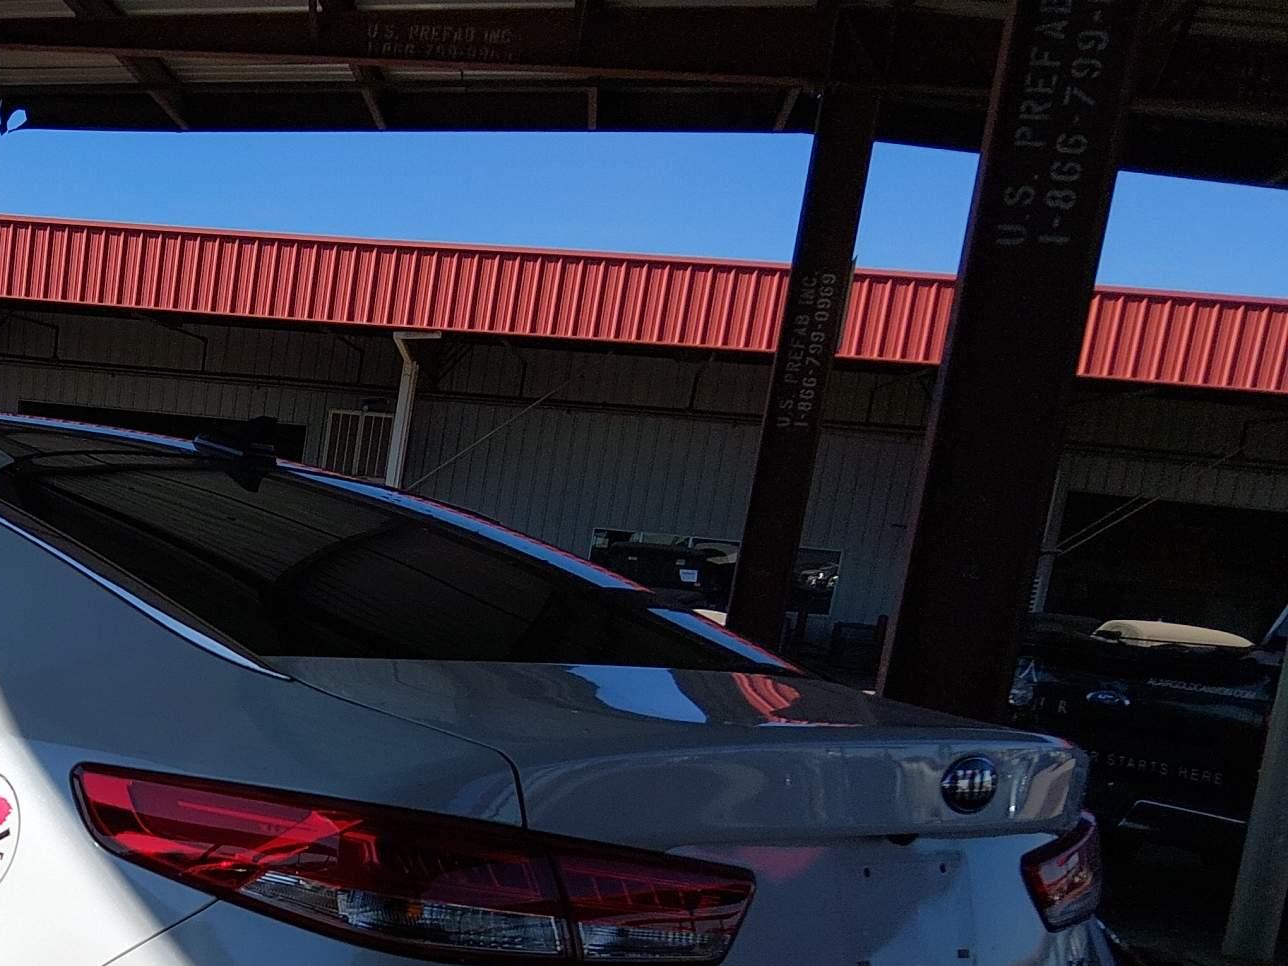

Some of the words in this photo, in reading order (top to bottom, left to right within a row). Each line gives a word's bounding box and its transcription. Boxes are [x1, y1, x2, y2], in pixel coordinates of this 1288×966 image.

[1038, 0, 1110, 243] 1-866-799-
[784, 314, 811, 384] PREFAB
[793, 272, 837, 428] 1-866-799-0969
[1104, 753, 1169, 777] STARTS
[1175, 765, 1224, 785] HERE
